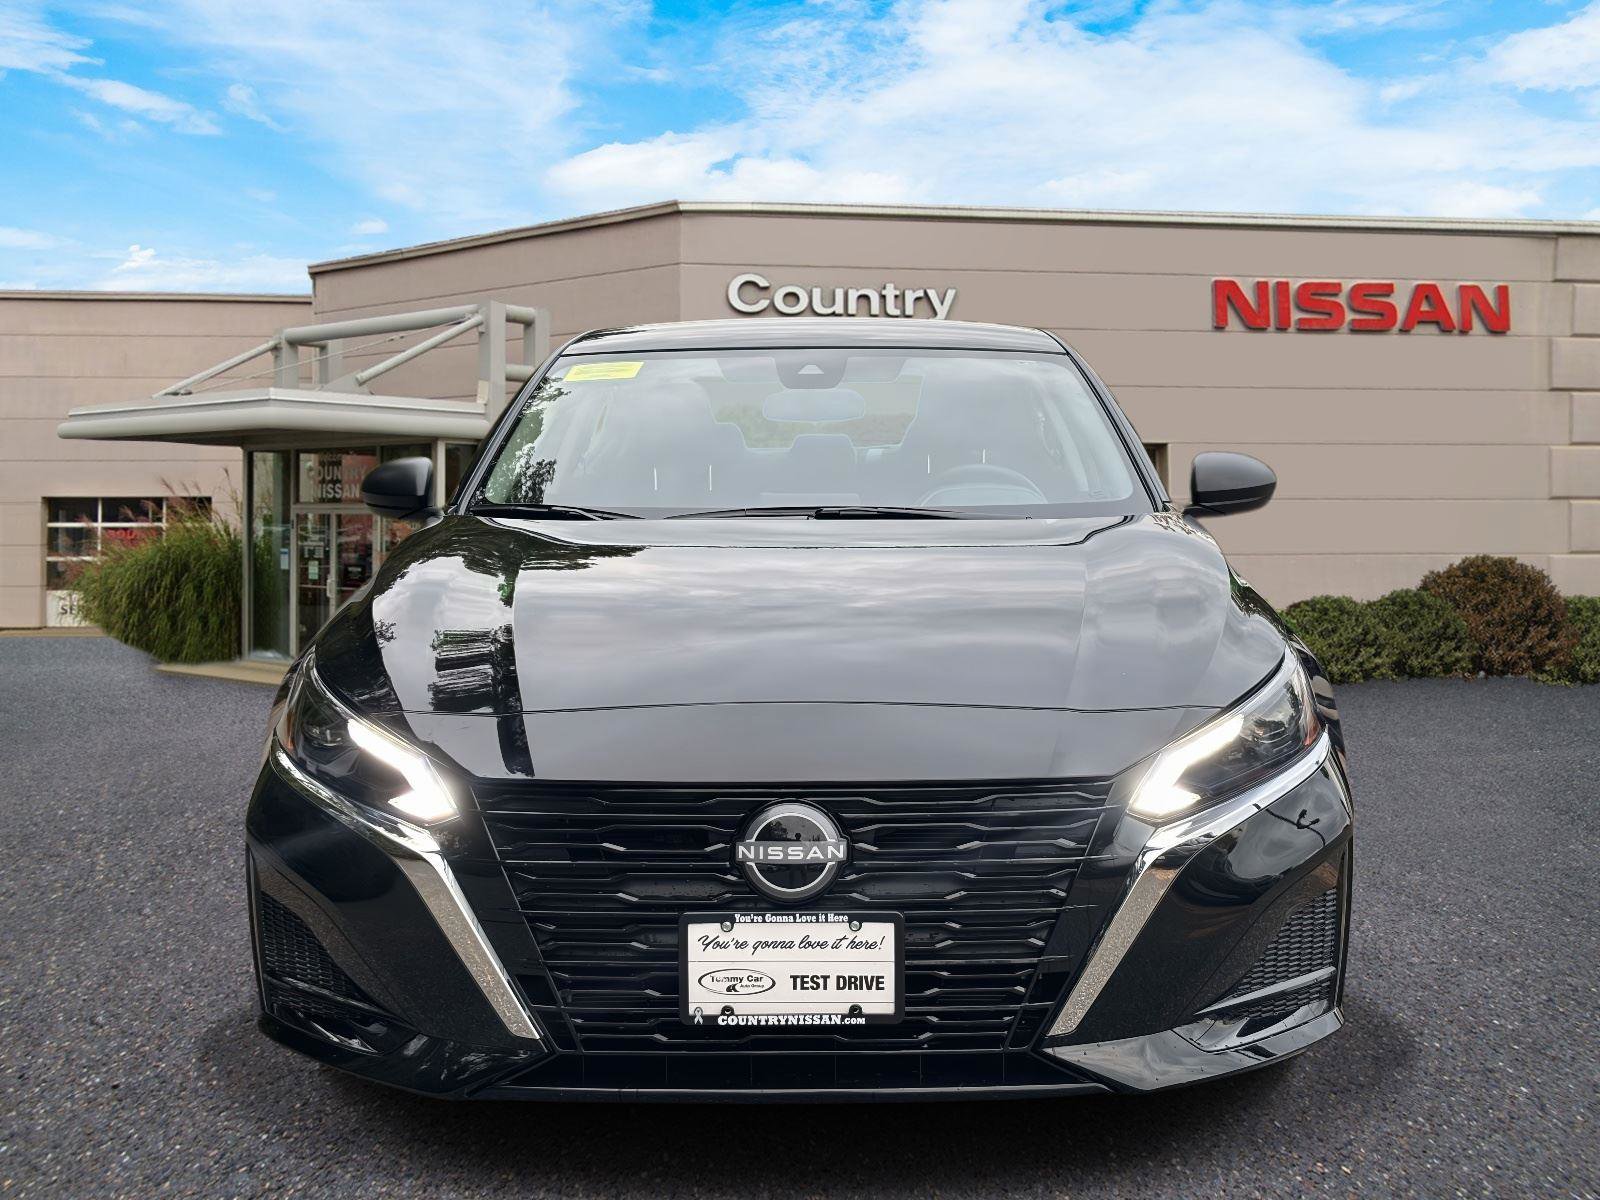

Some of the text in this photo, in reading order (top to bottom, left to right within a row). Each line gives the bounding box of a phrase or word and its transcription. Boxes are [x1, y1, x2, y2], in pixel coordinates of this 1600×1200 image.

[727, 273, 957, 320] Country
[1212, 279, 1511, 334] NISSAN
[738, 845, 844, 860] NISSAN
[735, 912, 848, 923] You're Gonna Love it Here
[698, 934, 886, 956] You're gonna love it here!
[746, 974, 763, 983] Car
[790, 974, 885, 991] TEST DRIVE
